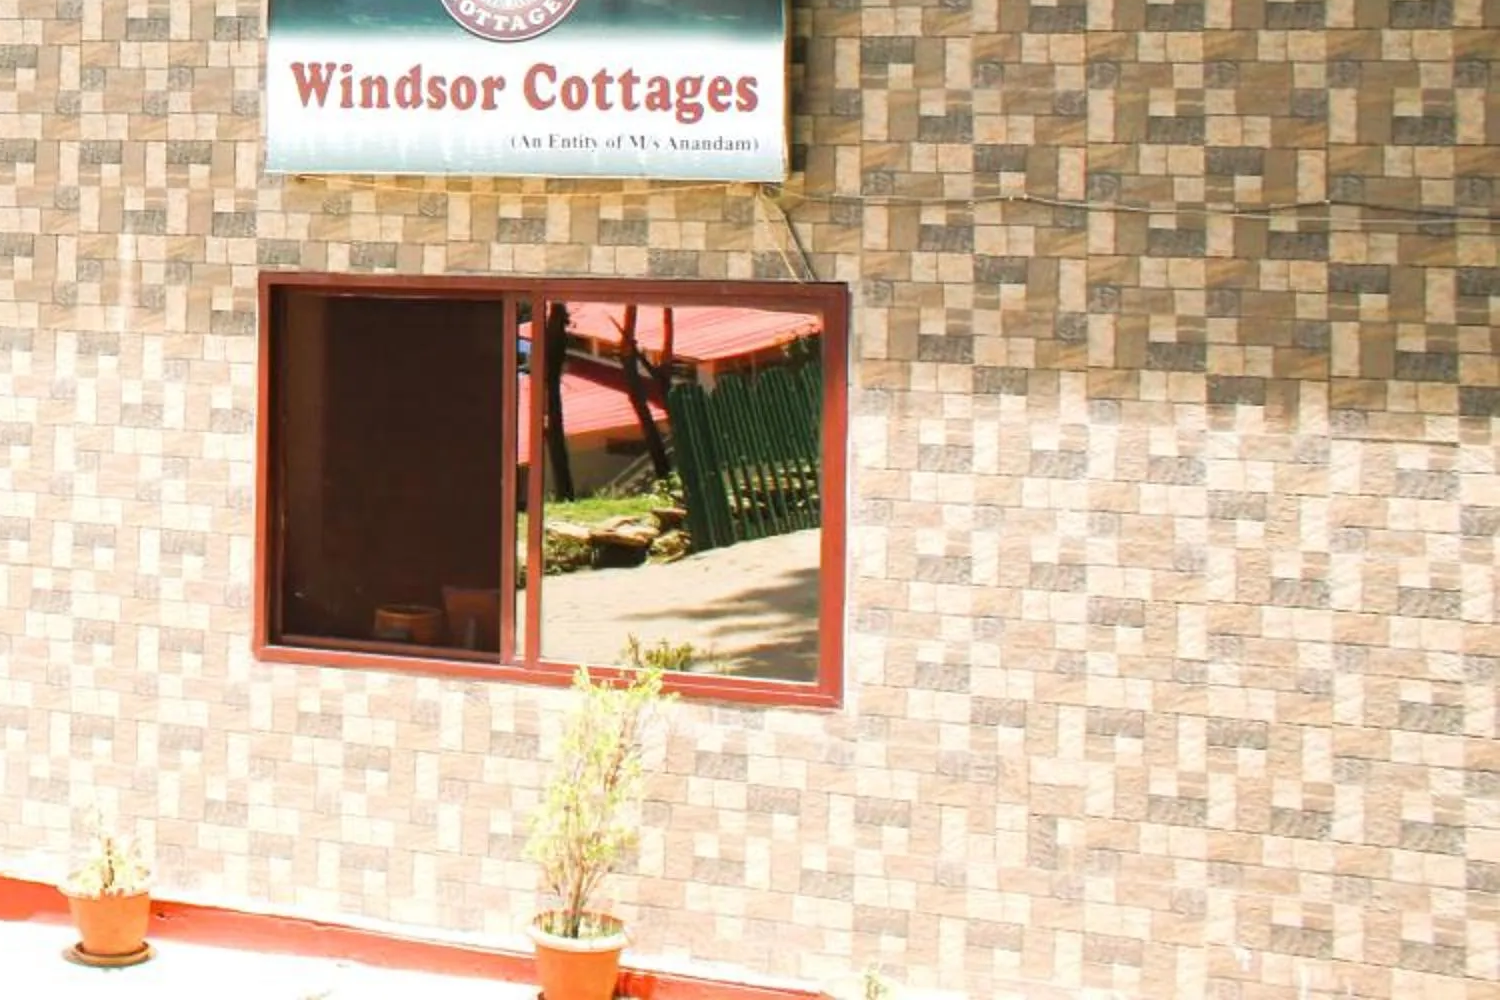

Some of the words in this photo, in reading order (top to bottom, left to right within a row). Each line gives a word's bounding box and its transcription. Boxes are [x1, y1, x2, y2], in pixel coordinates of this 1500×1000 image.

[290, 61, 506, 111] Windsor
[523, 62, 759, 124] Cottages
[510, 133, 542, 150] (An
[548, 133, 598, 152] Entity
[605, 134, 622, 150] of
[666, 136, 759, 152] Anandam)
